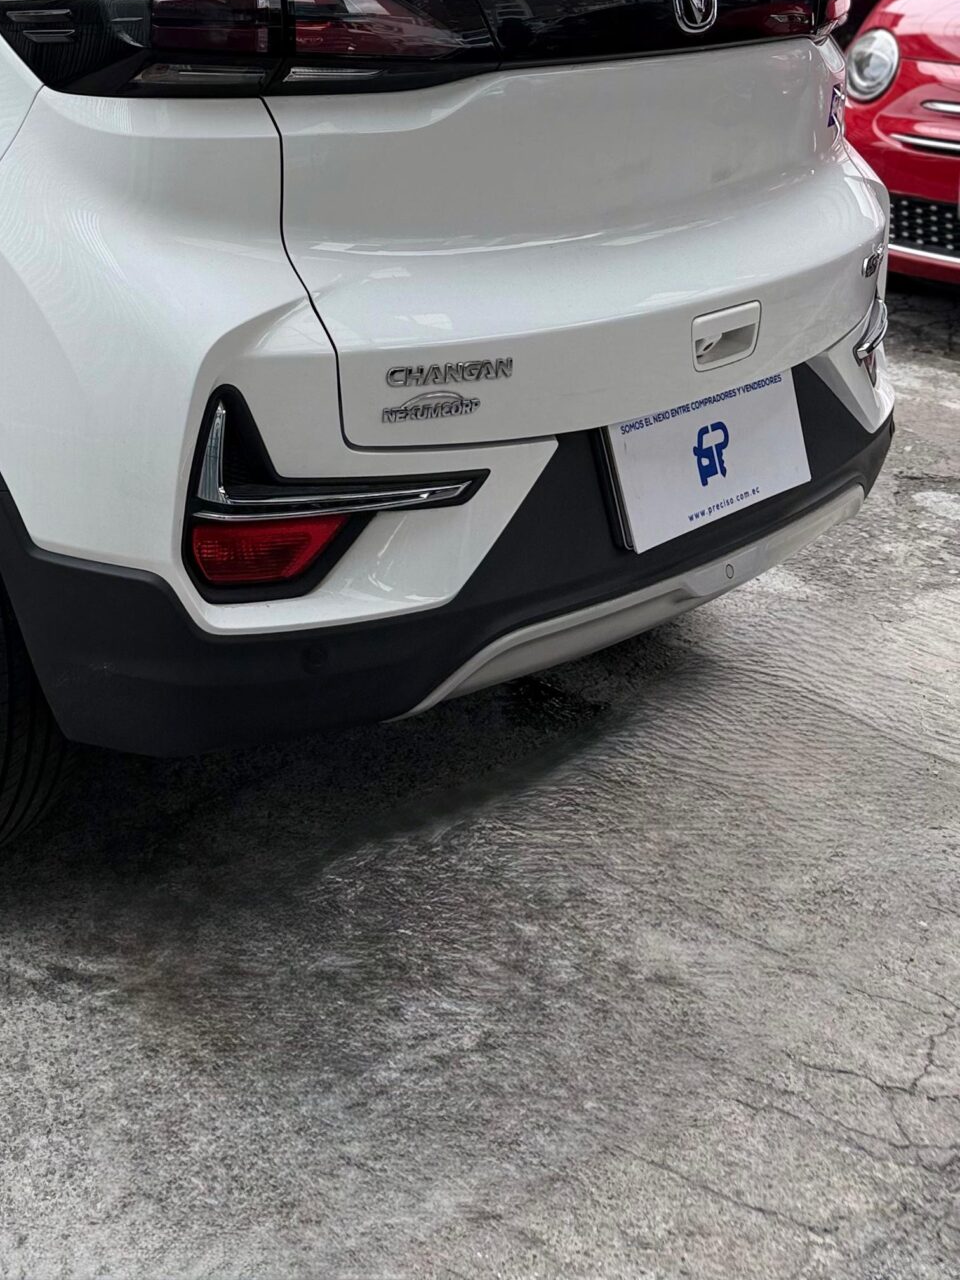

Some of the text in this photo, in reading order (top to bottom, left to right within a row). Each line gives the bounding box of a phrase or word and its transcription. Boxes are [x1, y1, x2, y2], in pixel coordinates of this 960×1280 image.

[386, 357, 513, 387] CHANGAN
[382, 398, 481, 423] NEXUMCORP
[620, 373, 782, 435] SOMOS EL NEXO ENTRE COMPRADORES Y VENDEDORES
[688, 486, 760, 521] www.preciso.com.ec
